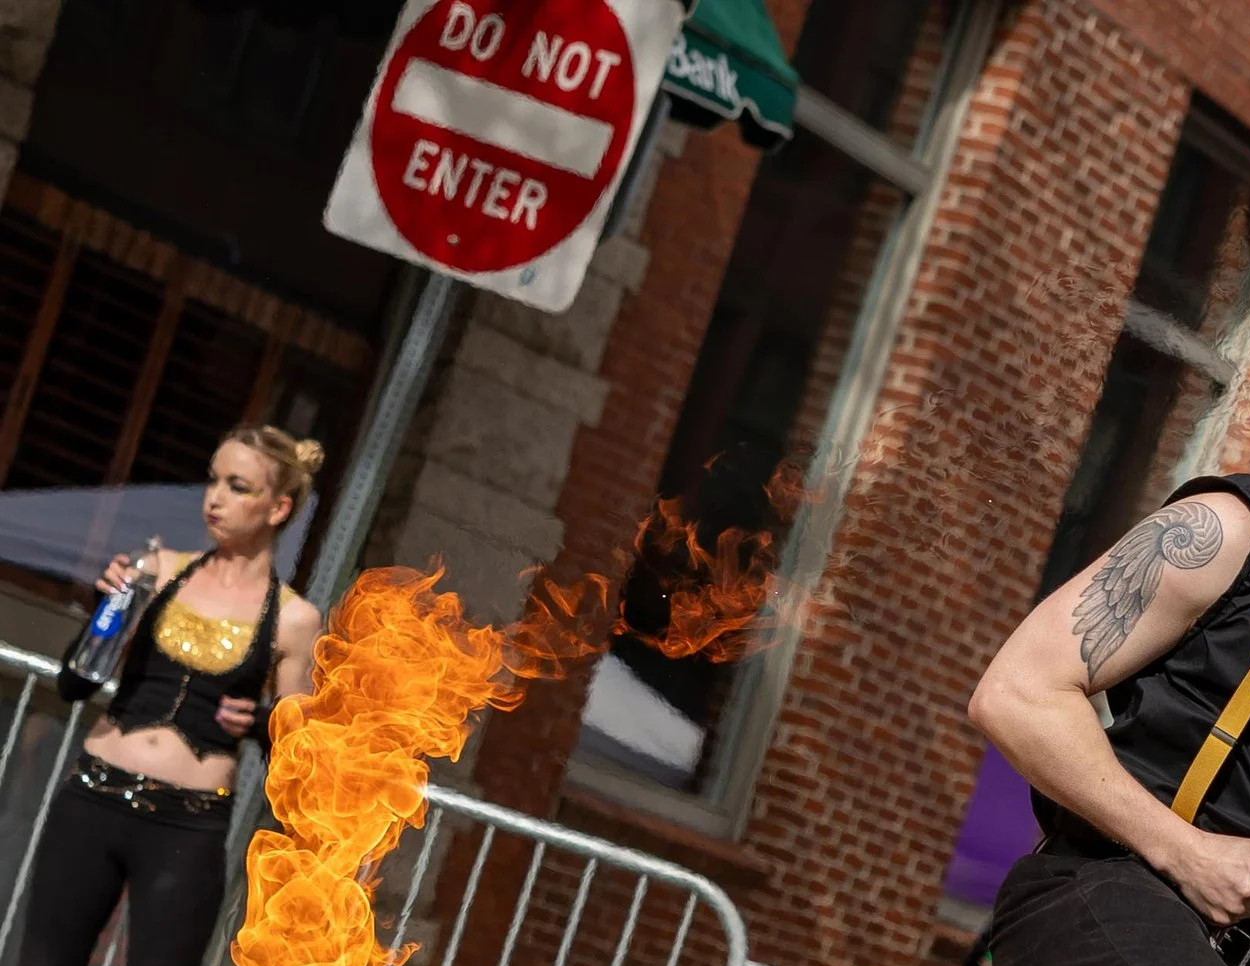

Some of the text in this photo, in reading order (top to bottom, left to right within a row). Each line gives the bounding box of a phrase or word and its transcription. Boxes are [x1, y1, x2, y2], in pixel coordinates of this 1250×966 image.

[439, 1, 622, 100] DO NOT
[667, 32, 741, 104] Bank
[402, 138, 549, 231] ENTER
